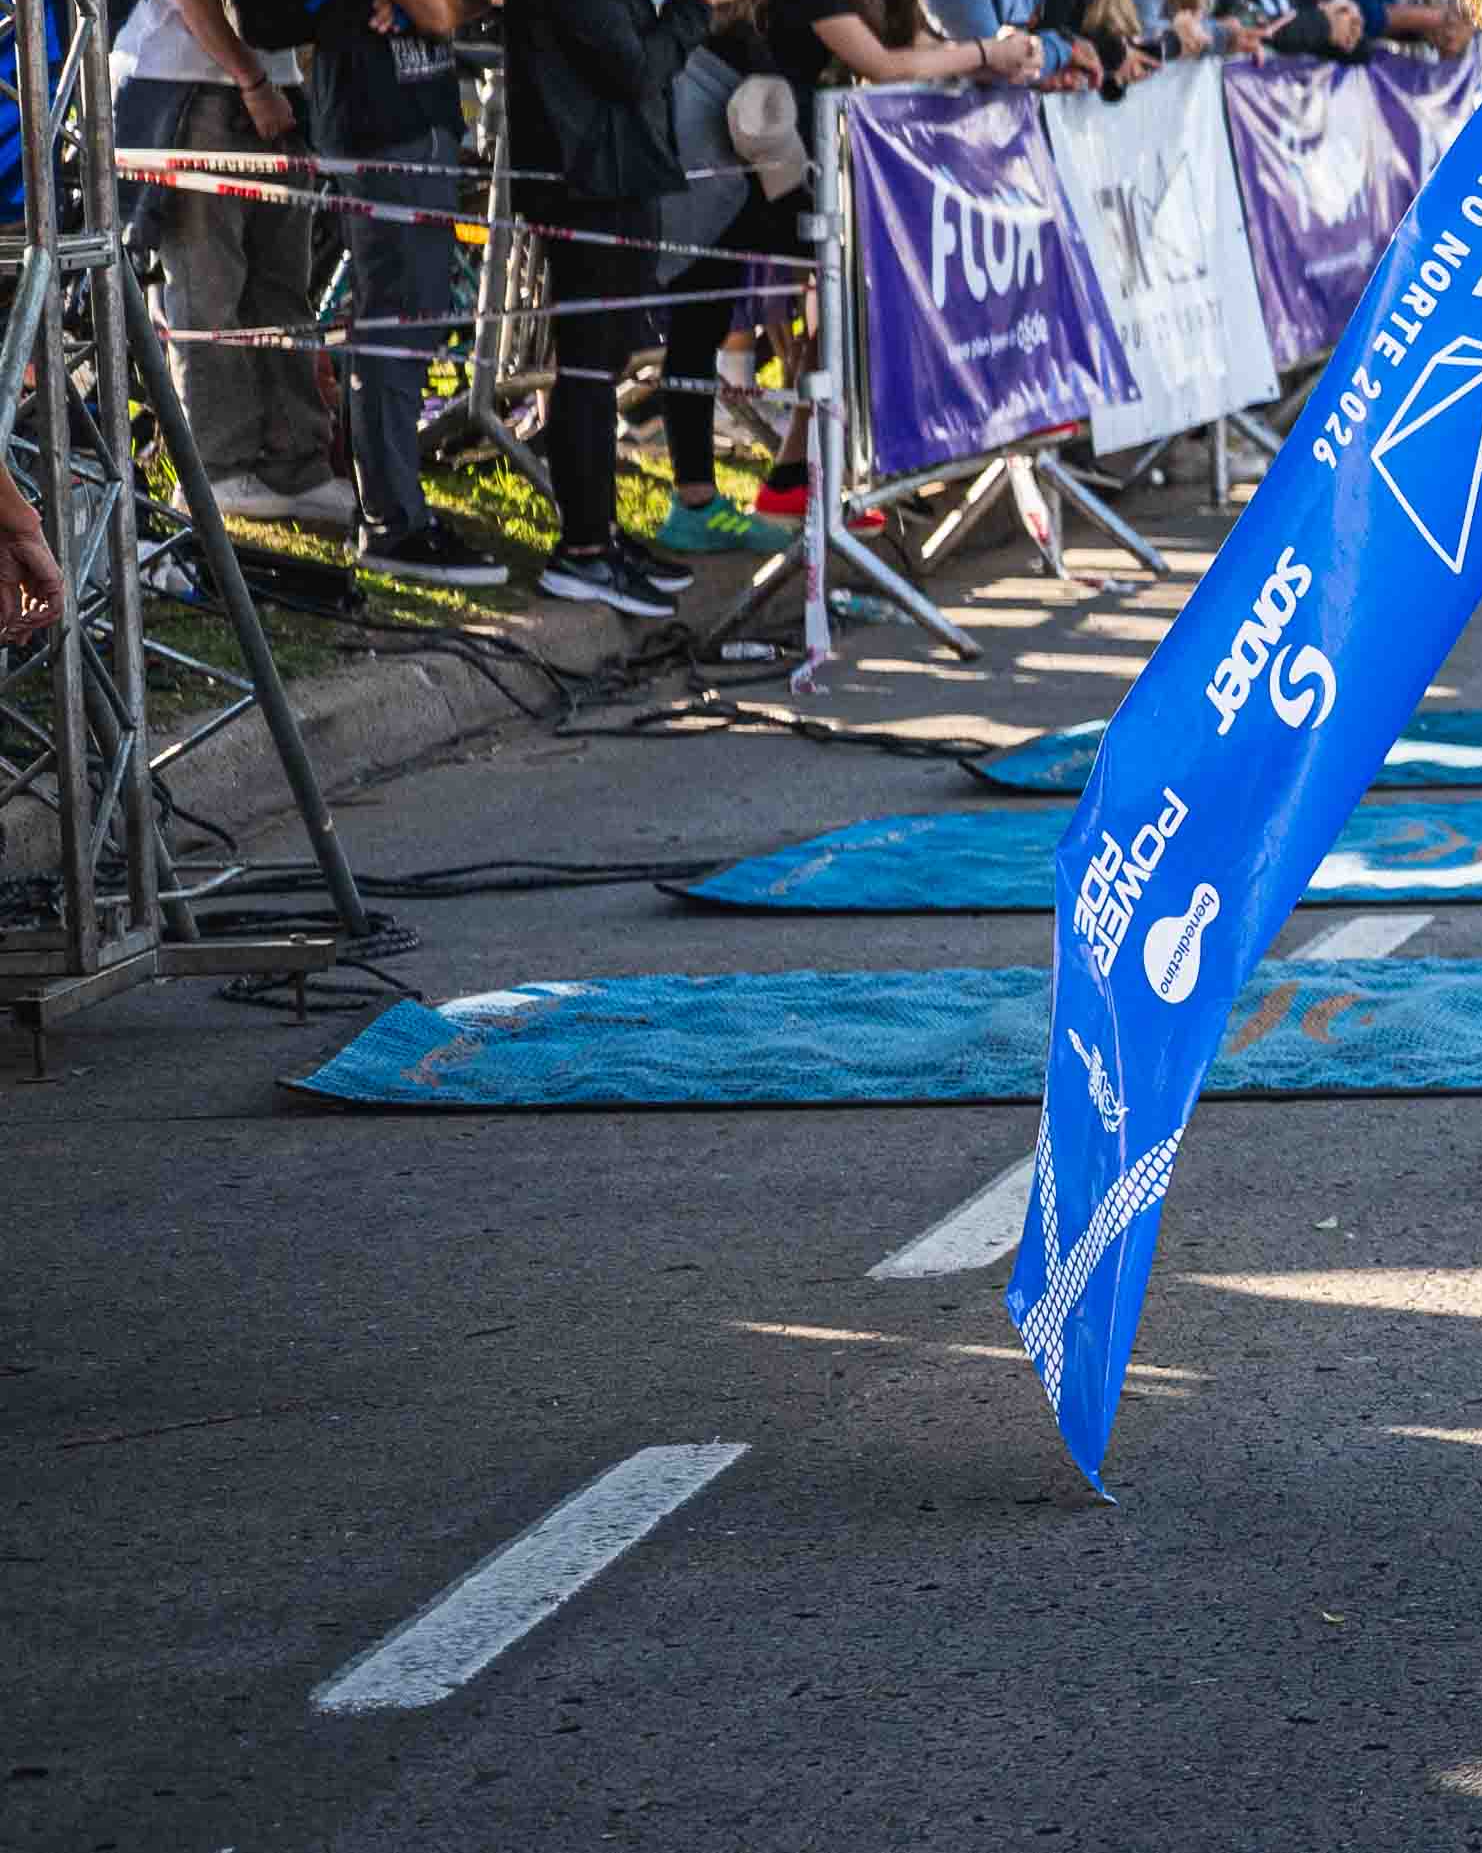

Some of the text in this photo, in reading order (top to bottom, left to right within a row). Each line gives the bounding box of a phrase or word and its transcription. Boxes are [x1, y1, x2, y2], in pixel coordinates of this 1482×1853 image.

[1372, 229, 1472, 367] NORTE
[1312, 365, 1382, 469] 2026
[1072, 829, 1124, 937] ADE
[1091, 785, 1190, 979] POWER
[1160, 890, 1217, 997] benedictino
